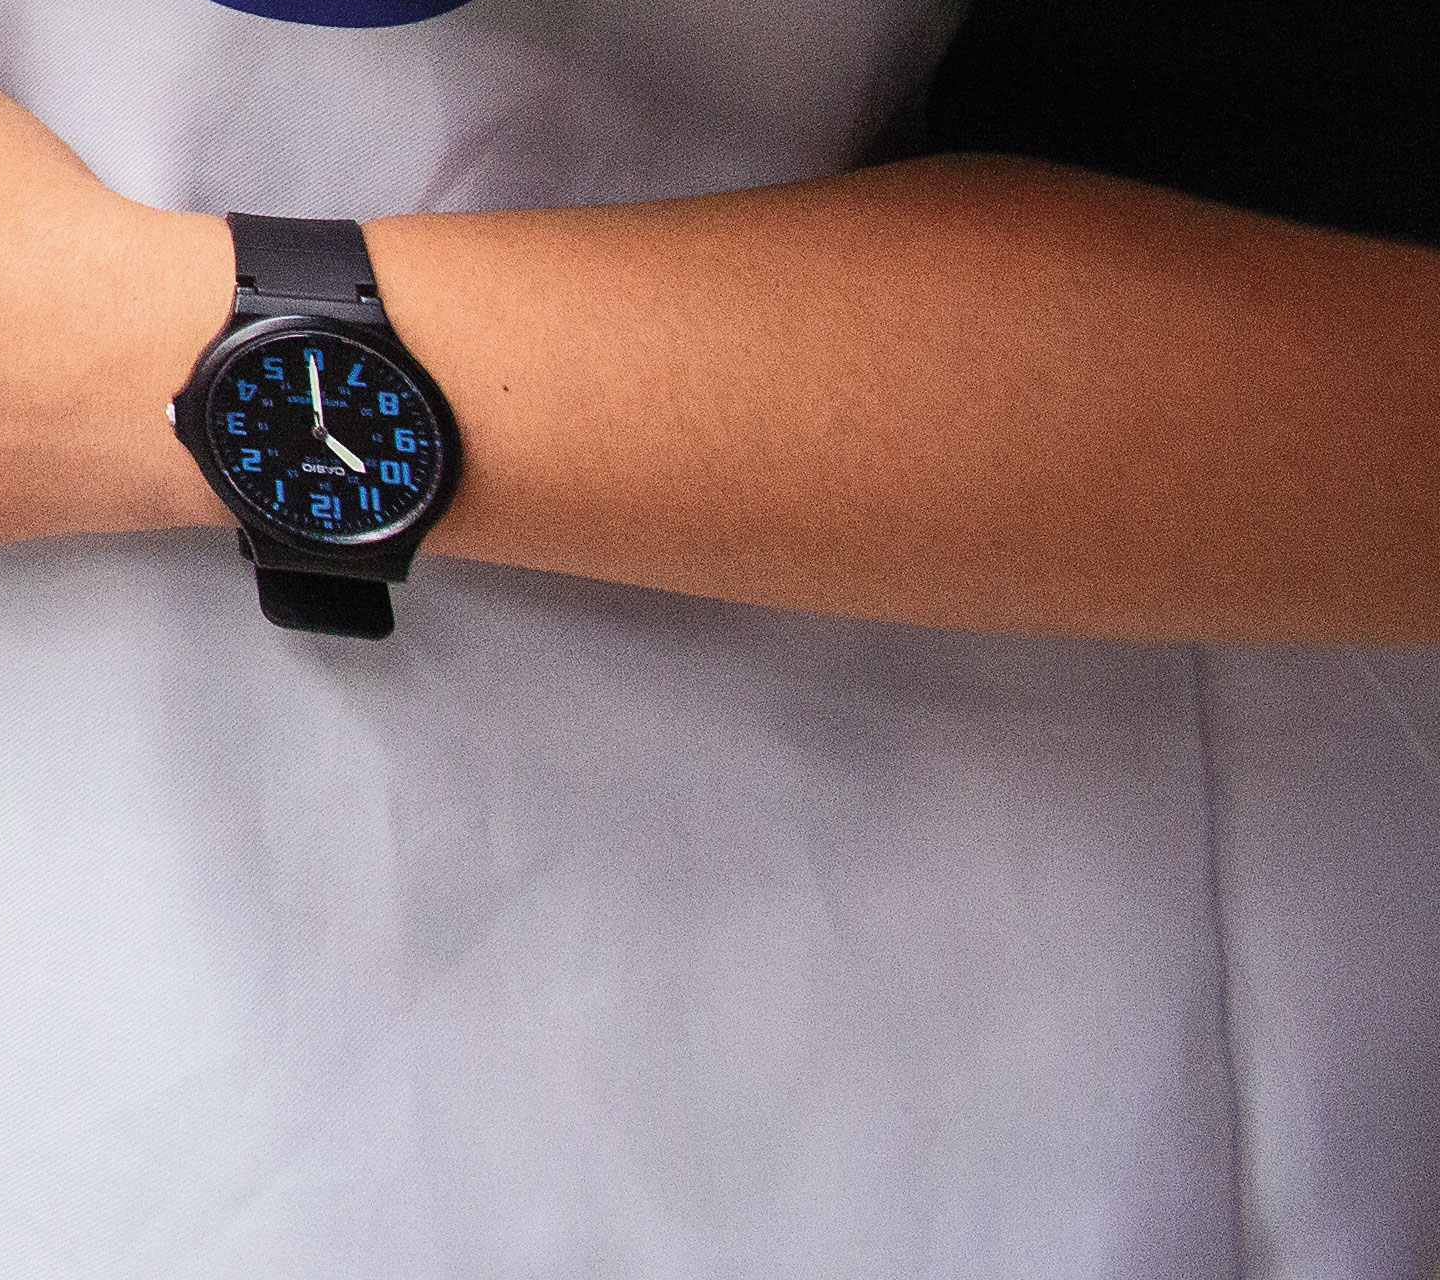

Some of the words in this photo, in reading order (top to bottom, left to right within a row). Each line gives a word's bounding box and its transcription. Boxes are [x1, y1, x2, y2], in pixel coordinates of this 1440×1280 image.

[263, 357, 283, 379] 5
[347, 364, 367, 387] 7
[237, 379, 257, 401] 4
[378, 391, 399, 415] 8
[226, 411, 247, 435] 3
[394, 428, 416, 452] 9
[241, 448, 262, 472] 2
[301, 463, 346, 476] CASIO
[380, 460, 412, 485] 10
[274, 479, 285, 503] 1
[358, 486, 382, 511] 11
[309, 493, 341, 519] 12
